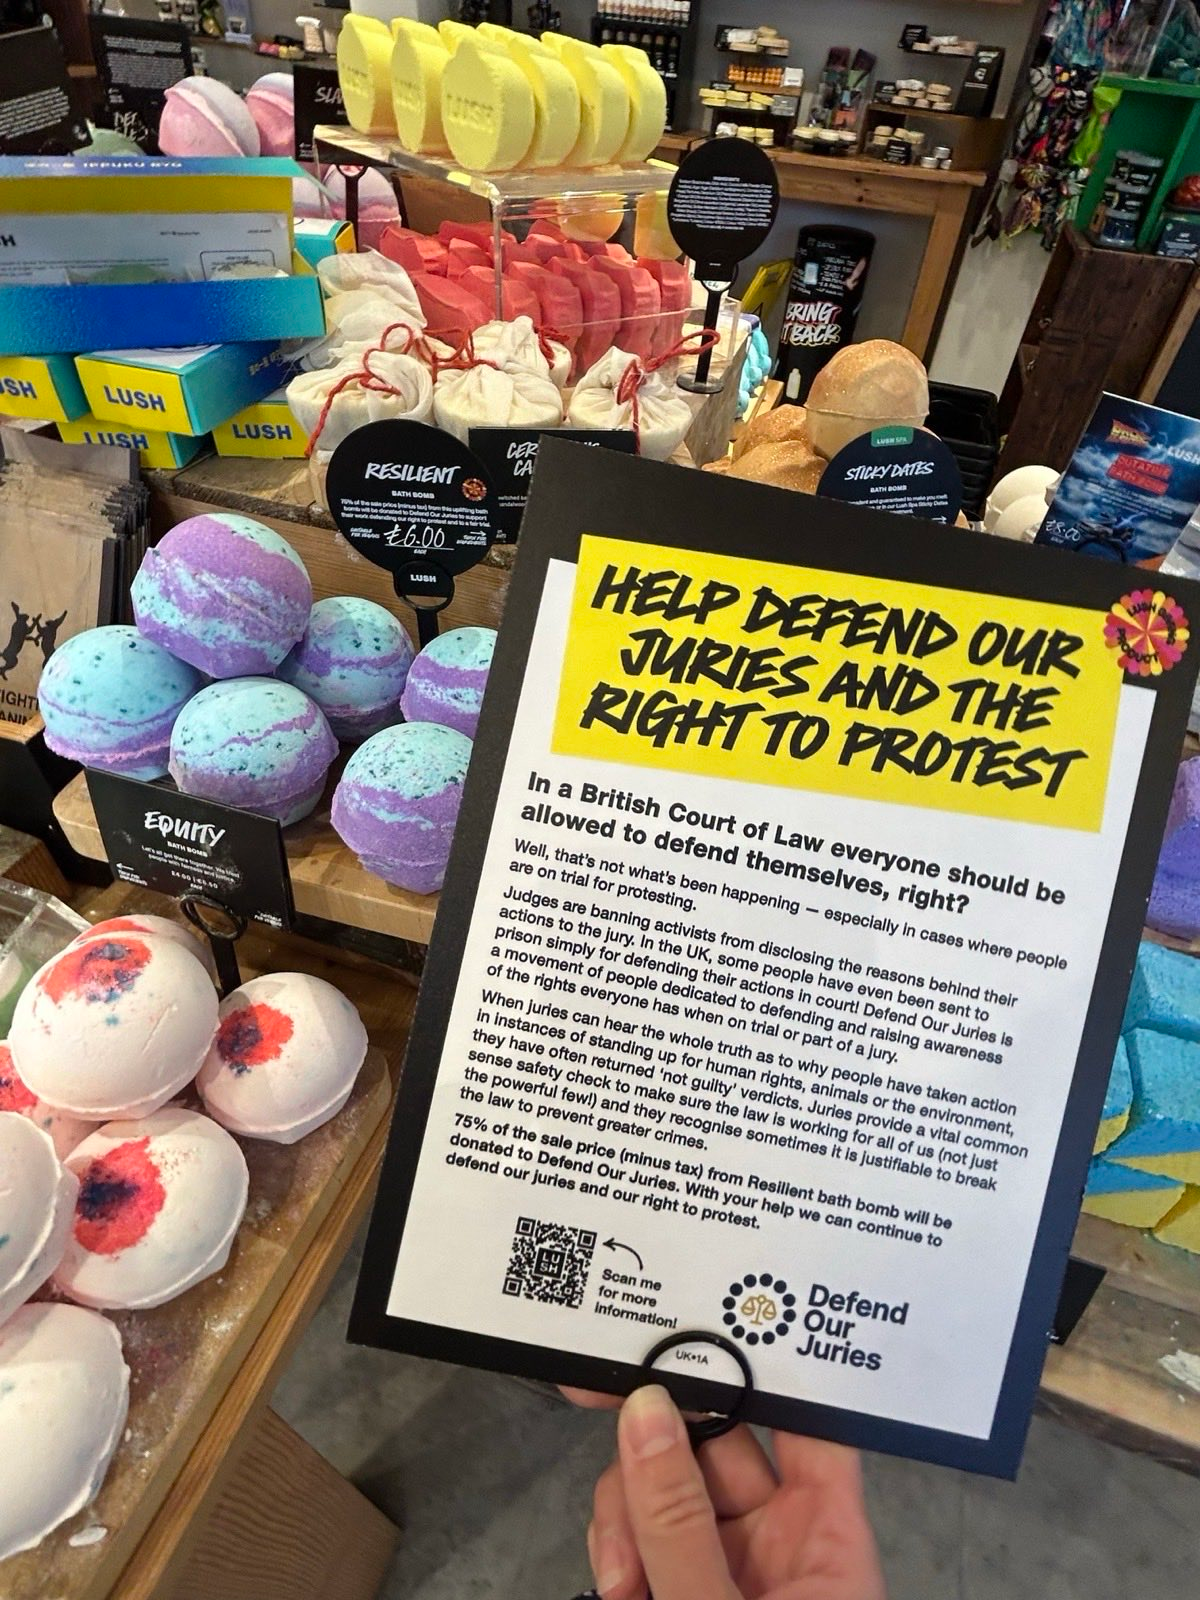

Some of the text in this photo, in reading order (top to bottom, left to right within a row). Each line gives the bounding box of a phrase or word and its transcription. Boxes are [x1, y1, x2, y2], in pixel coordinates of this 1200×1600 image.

[790, 323, 841, 346] BACK
[103, 385, 166, 412] LUSH
[83, 431, 150, 449] LUSH
[232, 423, 293, 440] LUSH
[364, 462, 462, 485] RESILIENT
[844, 460, 935, 481] STICKY DATES
[391, 490, 436, 500] BATH BOMB
[383, 523, 446, 548] £6.00
[410, 574, 437, 583] LUSH
[590, 564, 1084, 680] HELP DEFEND OUR
[620, 627, 1062, 734] JURIES AND THE
[579, 681, 1090, 799] RIGHT TO PROTEST
[144, 811, 227, 847] EQUITY
[527, 770, 1066, 906] In a British Court of Law everyone should be
[167, 841, 208, 858] BATH BOMB
[520, 802, 970, 915] allowed to defend themselves, right?
[514, 837, 550, 861] Well,
[598, 859, 626, 876] not
[679, 873, 718, 895] been
[720, 882, 801, 916] happening
[824, 908, 900, 937] especially
[902, 921, 916, 938] in
[919, 928, 964, 948] cases
[967, 938, 1014, 959] where
[1015, 949, 1068, 971] people
[454, 1112, 953, 1230] 75% of the sale price (minus tax) from Resilient bath bomb will be
[449, 1132, 943, 1248] donated to Defend Our Juries. With your help we can continue to
[601, 1268, 662, 1292] Scan me
[598, 1285, 657, 1307] for more
[808, 1283, 910, 1326] Defend
[594, 1301, 678, 1329] information!
[803, 1309, 856, 1339] Our
[796, 1334, 883, 1371] Juries
